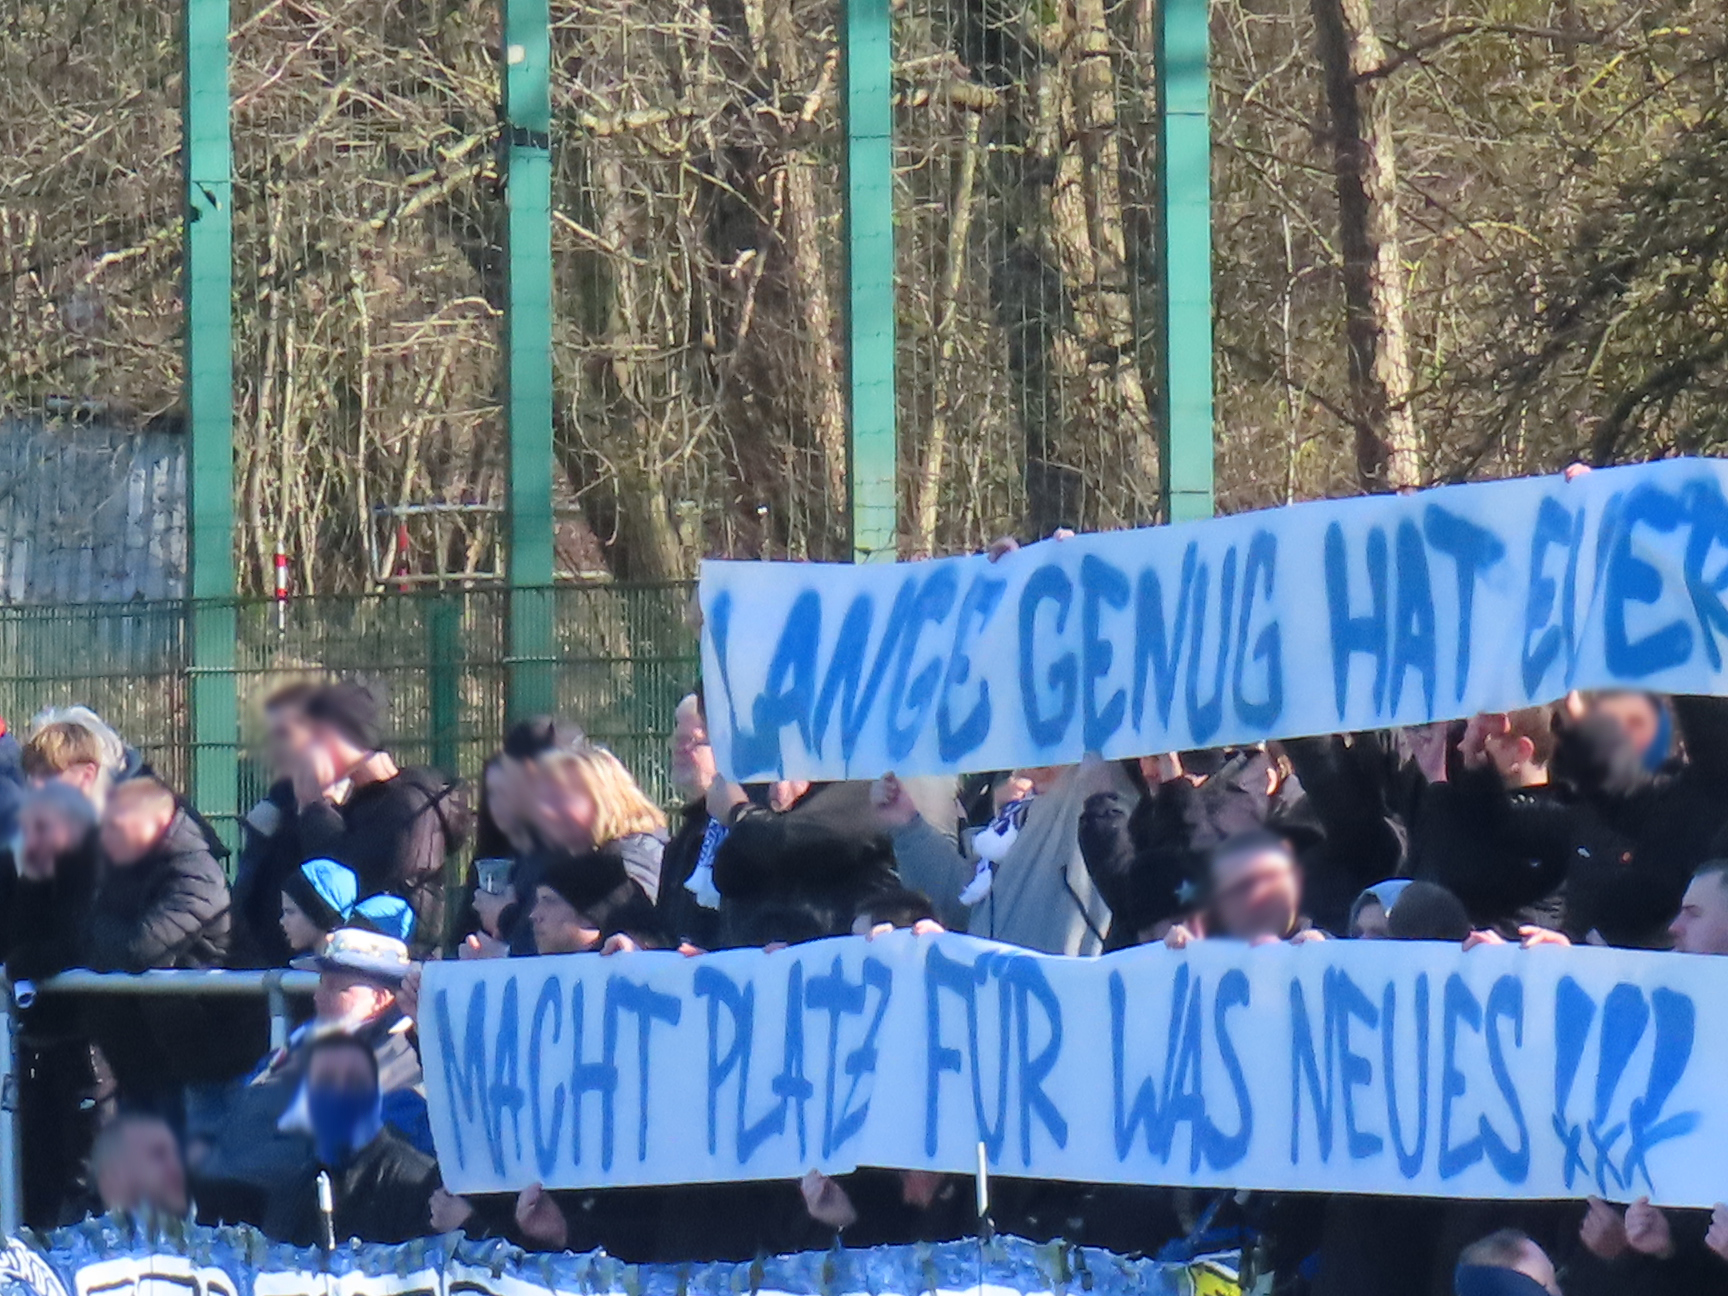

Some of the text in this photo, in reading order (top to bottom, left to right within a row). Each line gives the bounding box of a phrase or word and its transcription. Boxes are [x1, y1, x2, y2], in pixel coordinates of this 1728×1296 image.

[706, 572, 1007, 781] LANGE
[1017, 530, 1282, 756] GENUG
[1322, 506, 1504, 719] HAT
[432, 972, 682, 1182] MACHT
[692, 950, 890, 1164] PLATZ
[1108, 962, 1252, 1174] WAS
